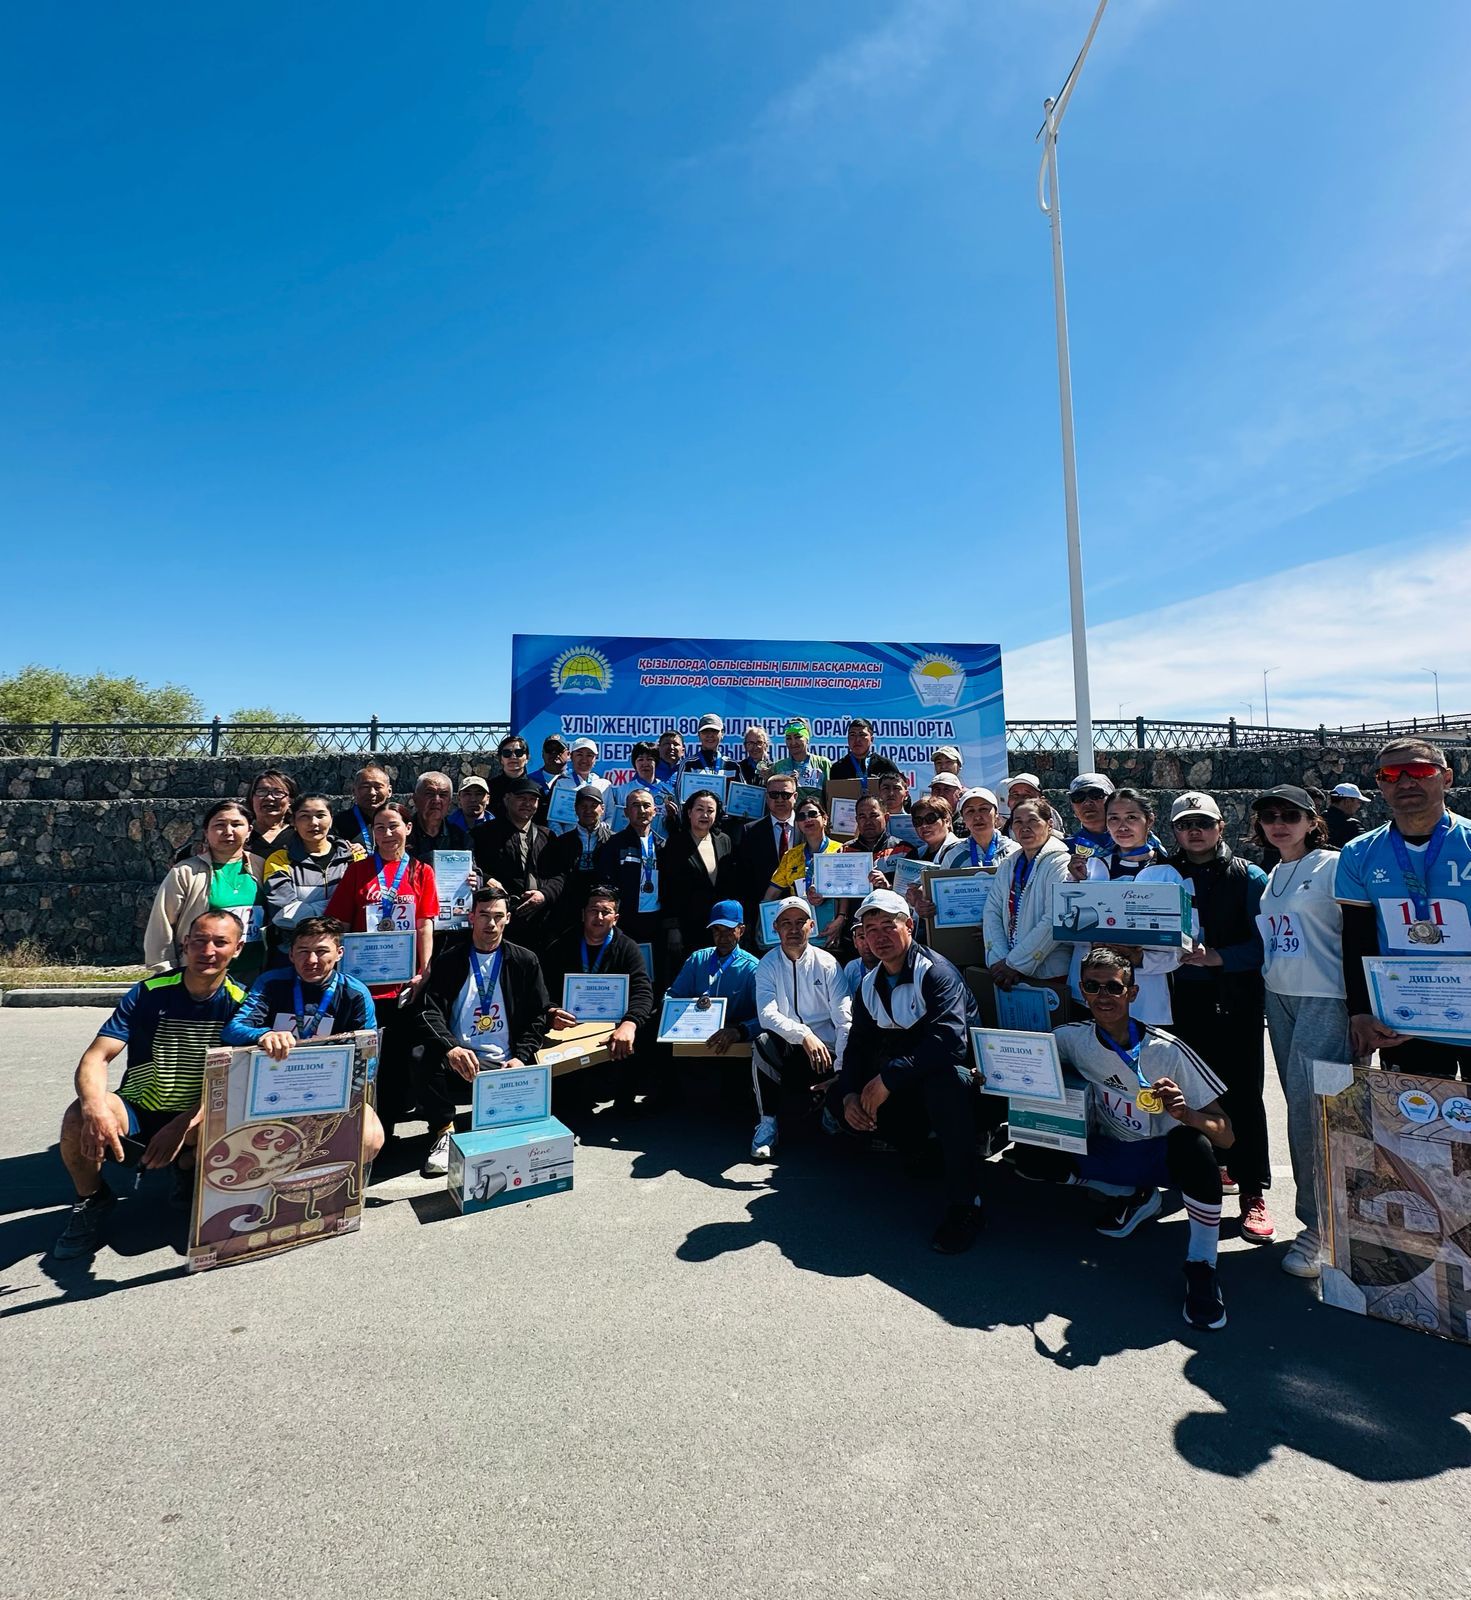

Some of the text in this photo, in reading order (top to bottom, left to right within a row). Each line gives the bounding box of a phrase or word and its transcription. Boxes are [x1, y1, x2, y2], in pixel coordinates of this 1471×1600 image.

[638, 658, 883, 673] ҚЫЗЫЛОРДА ОБЛЫСЫНЫҢ БІЛІМ БАСҚАРМАСЫ
[640, 674, 881, 690] ҚЫЗЫЛОРДА ОБЛЫСЫНЫҢ БІЛІМ КӘСІПОДАҒЫ
[562, 716, 599, 735] ҰЛЫ
[679, 717, 699, 736] 80
[871, 719, 914, 738] АЛПЫ
[917, 720, 955, 738] ОРТА
[603, 743, 634, 762] БЕР
[1268, 914, 1294, 936] 1/2
[1408, 975, 1462, 984] ДИПЛОМ
[1000, 1045, 1033, 1055] ДИПЛОМ
[284, 1063, 324, 1073] ДИПЛОМ
[498, 1080, 529, 1090] ДИПЛОМ
